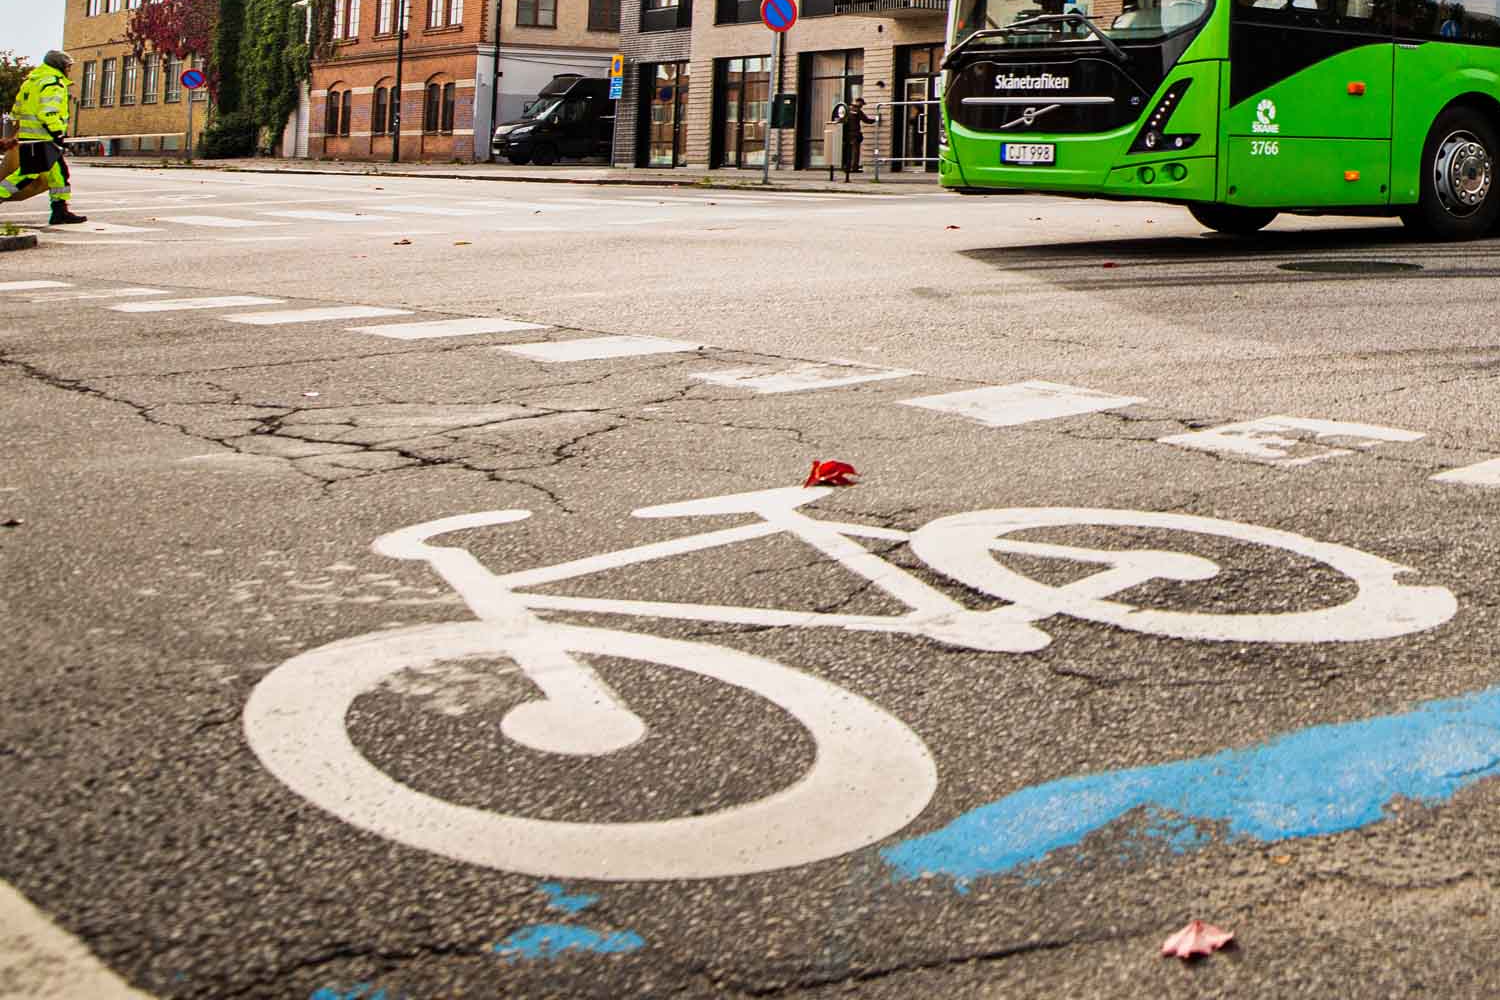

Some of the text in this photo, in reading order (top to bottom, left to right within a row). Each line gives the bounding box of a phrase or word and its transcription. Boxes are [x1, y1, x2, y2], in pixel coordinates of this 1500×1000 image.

[994, 73, 1070, 89] Skånetrafiken
[1030, 146, 1050, 160] 998
[1250, 140, 1279, 155] 3766
